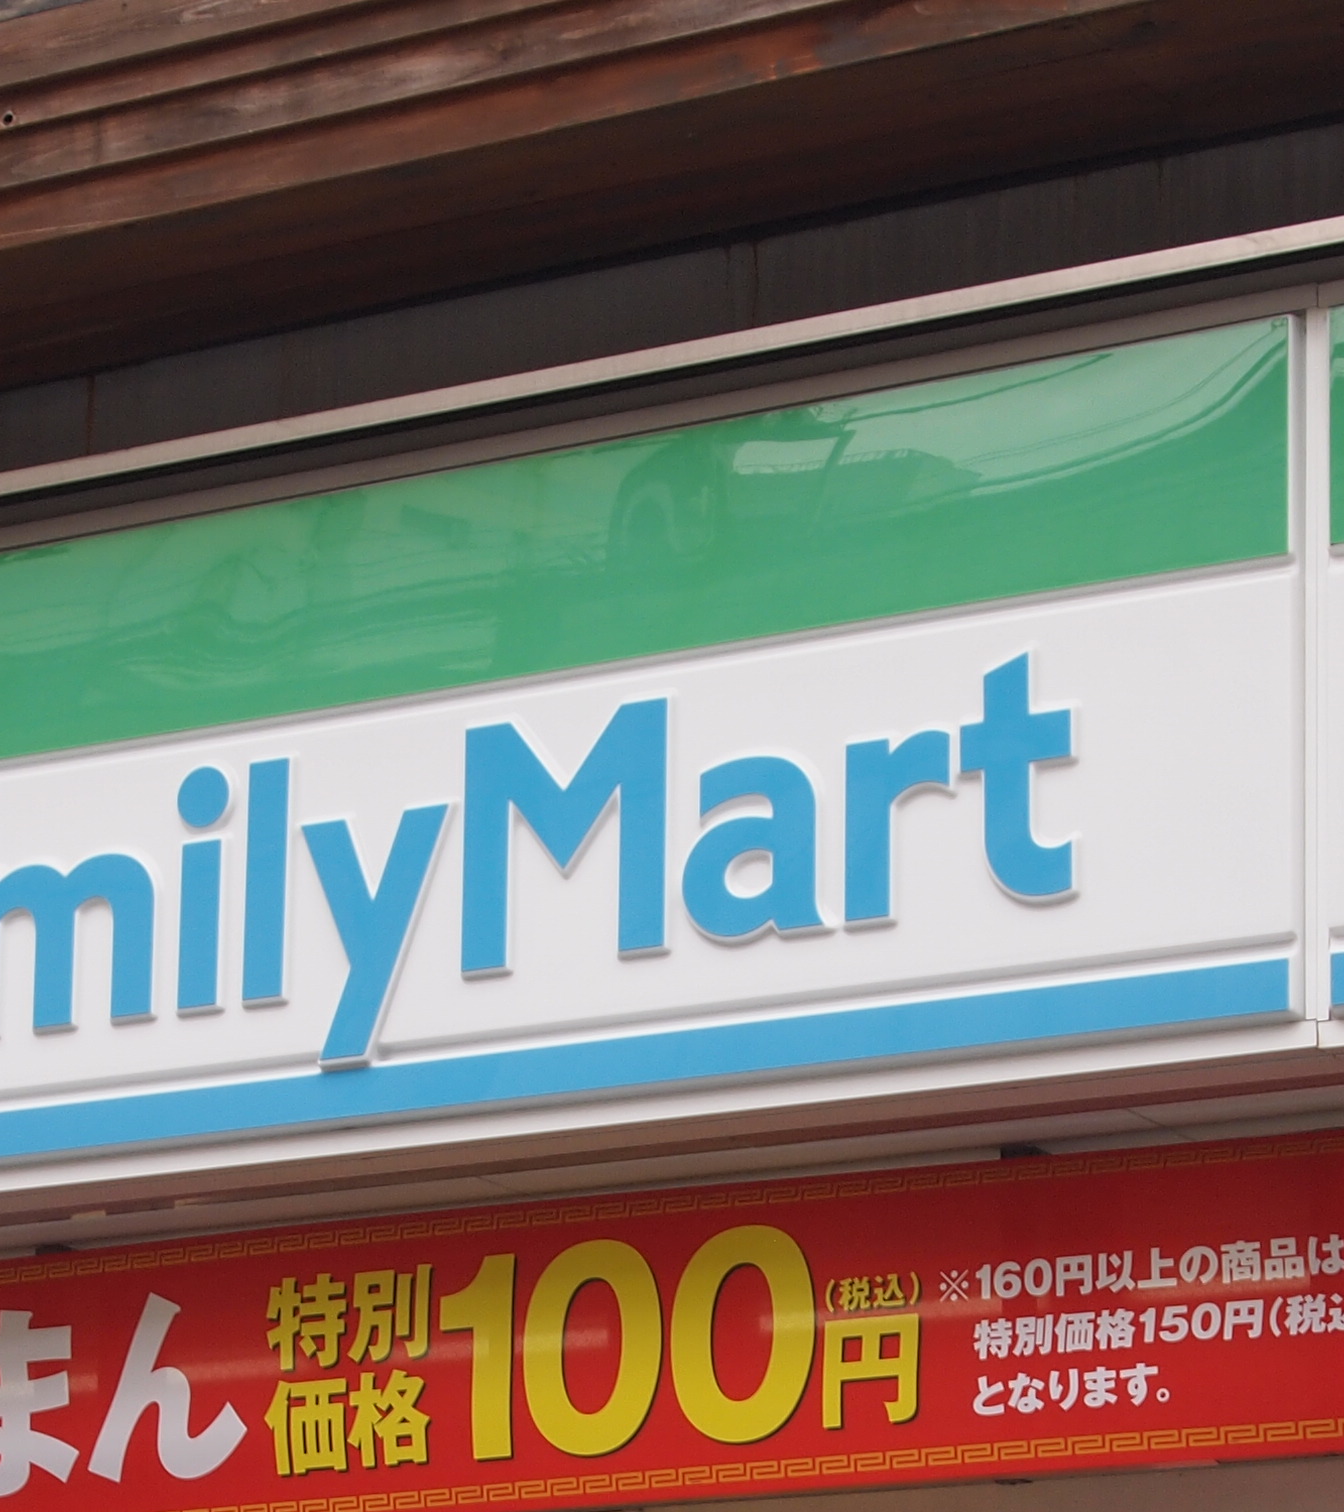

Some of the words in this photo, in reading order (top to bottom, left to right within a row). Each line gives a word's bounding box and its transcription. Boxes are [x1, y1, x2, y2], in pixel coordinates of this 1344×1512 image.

[264, 1263, 434, 1374] 特別
[823, 1272, 922, 1312] (税込)
[263, 1371, 434, 1479] 価格
[972, 1361, 1173, 1417] となります。
